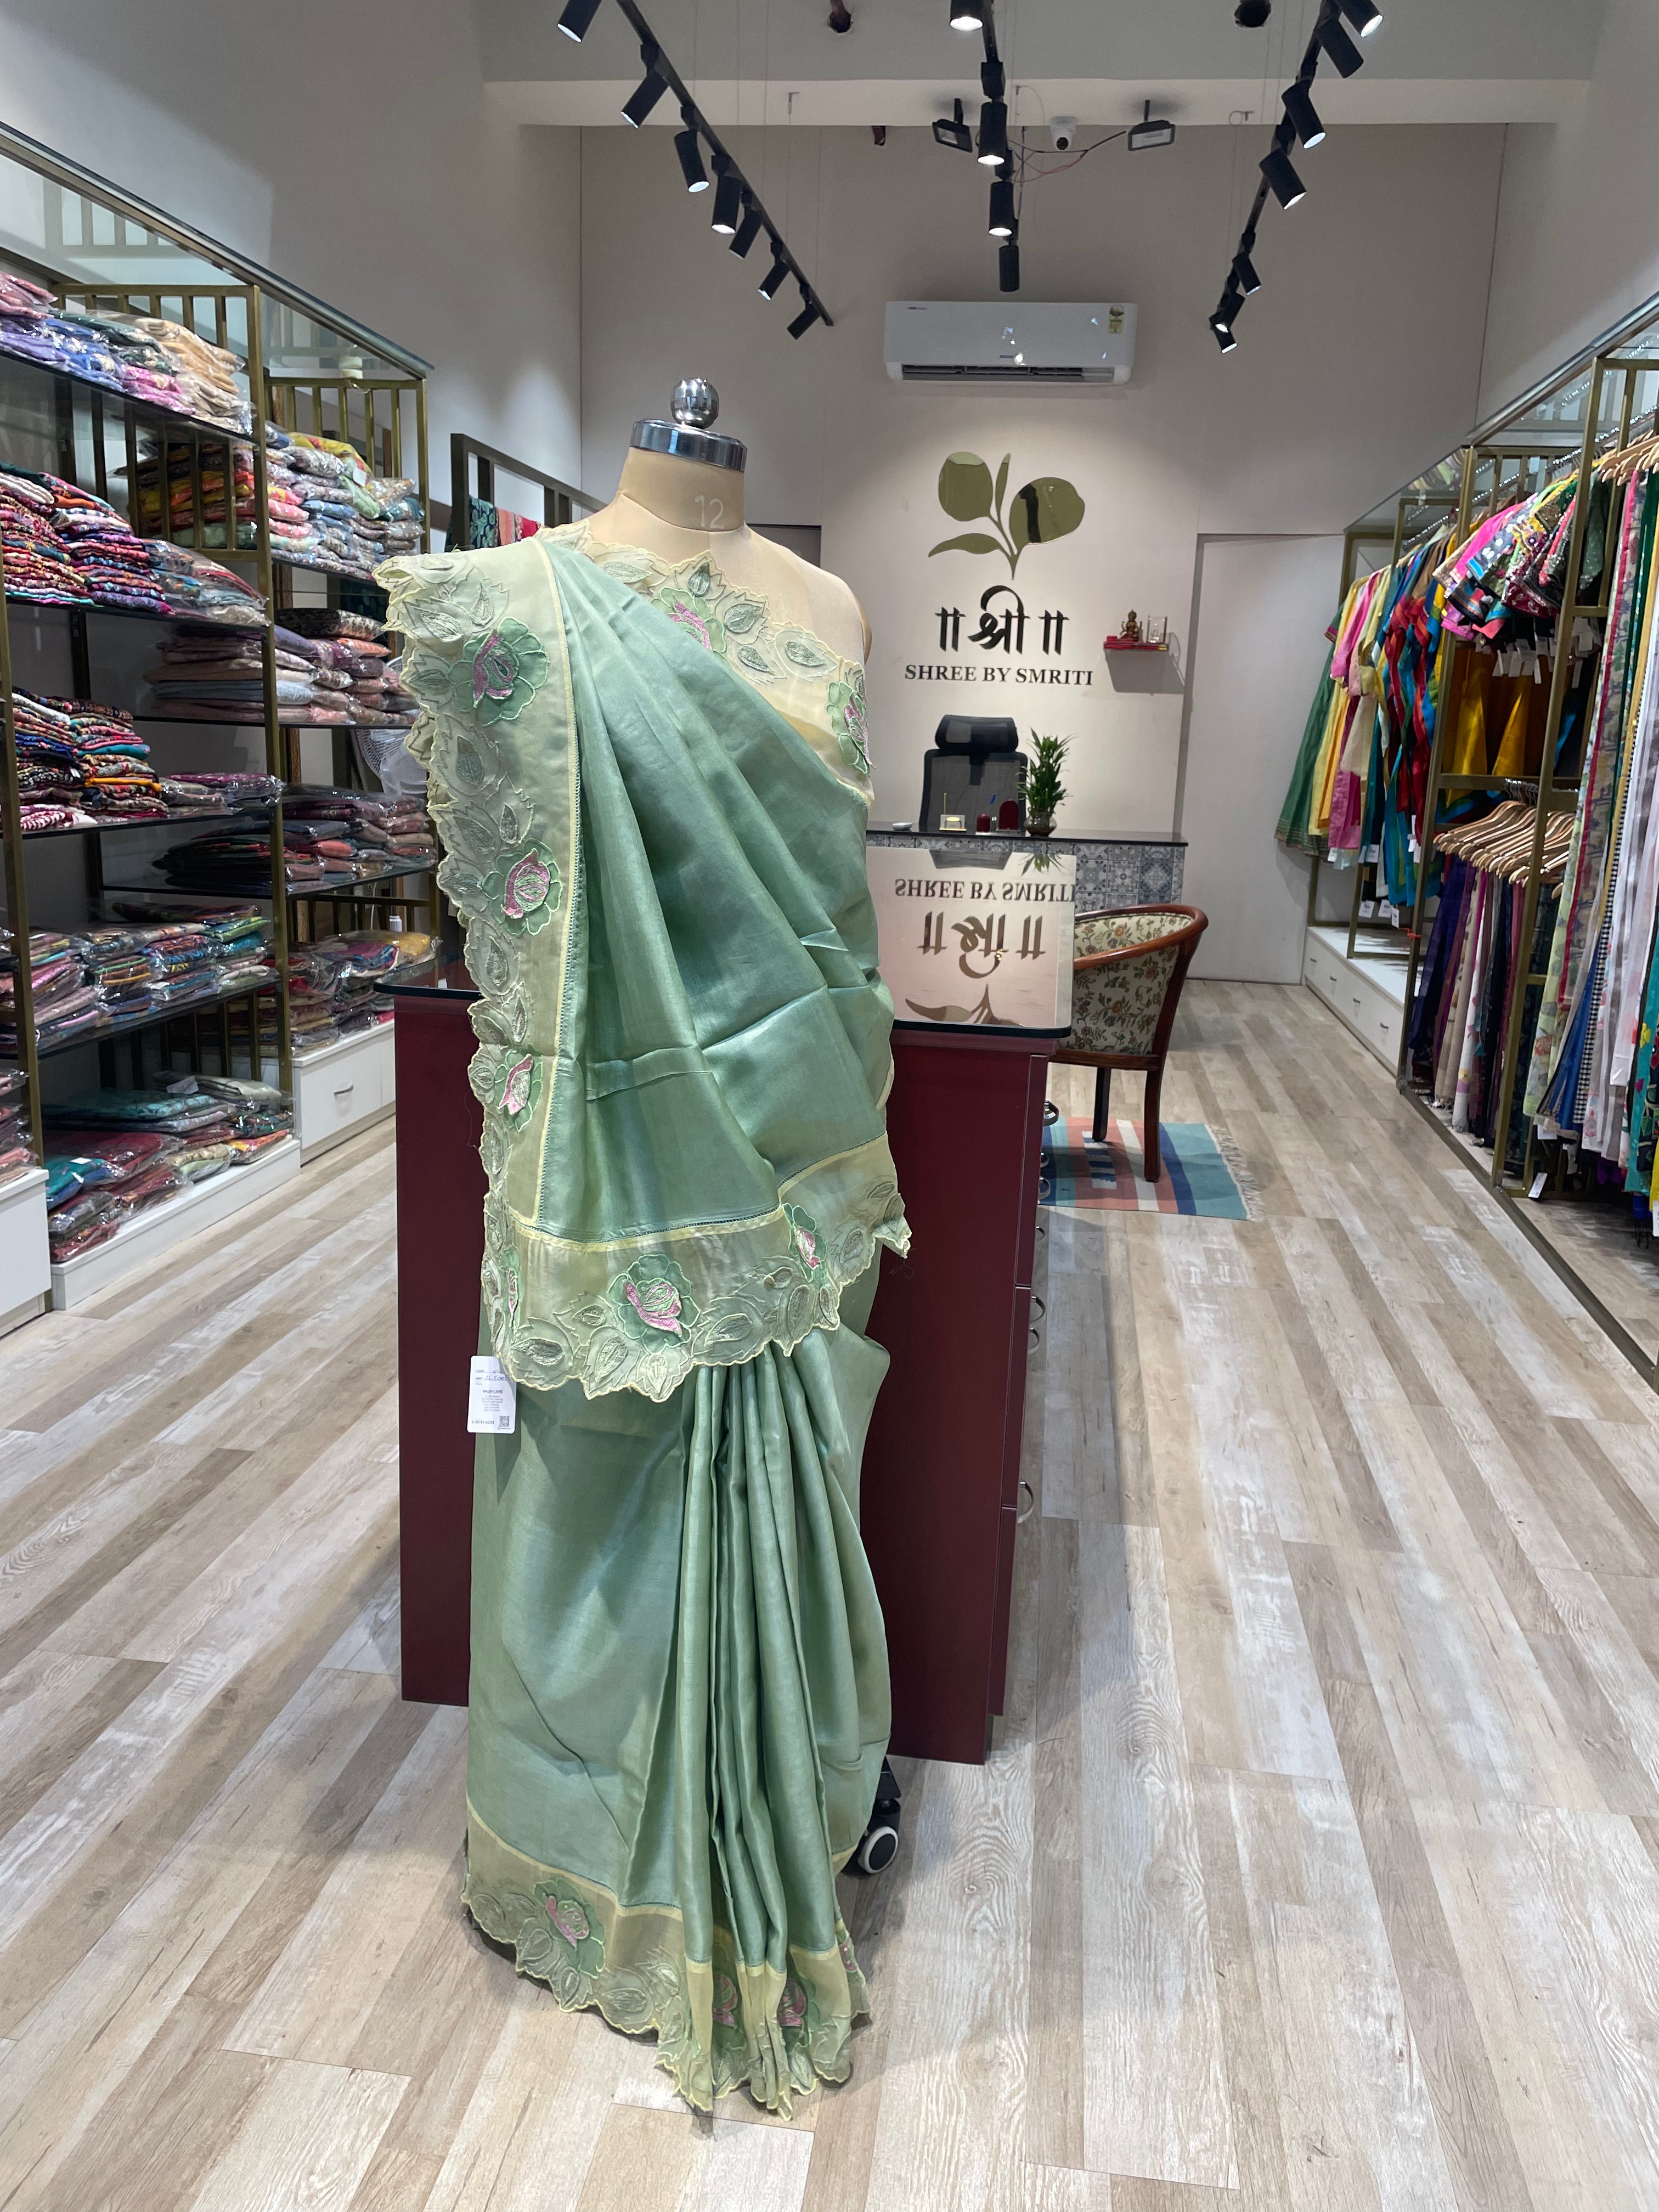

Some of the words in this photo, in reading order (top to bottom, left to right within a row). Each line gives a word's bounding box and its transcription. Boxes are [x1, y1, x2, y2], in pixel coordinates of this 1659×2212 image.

[694, 494, 725, 529] 12
[905, 664, 977, 681] SHREE
[982, 667, 1011, 682] BY
[1015, 668, 1093, 686] SMRITI
